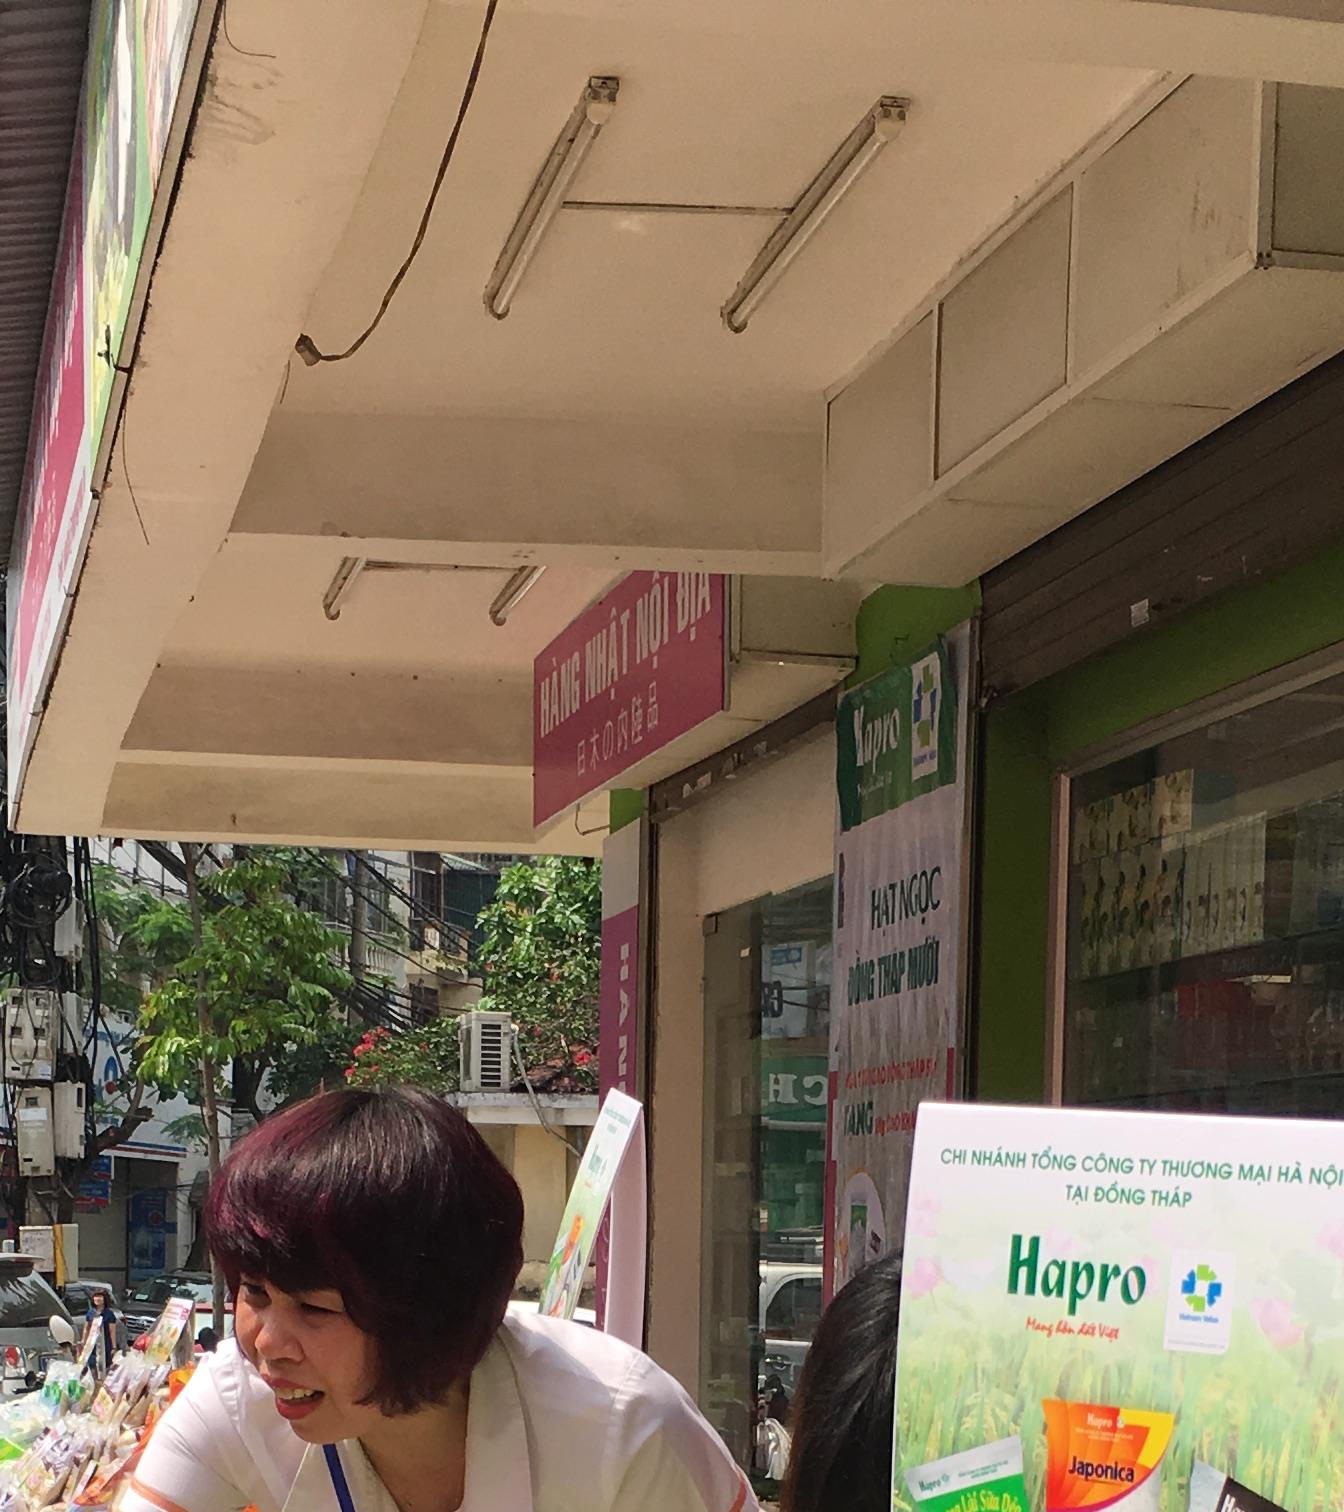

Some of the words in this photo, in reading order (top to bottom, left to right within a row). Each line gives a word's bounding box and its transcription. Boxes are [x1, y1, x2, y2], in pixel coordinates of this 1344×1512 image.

[541, 651, 580, 738] HÀNG
[585, 607, 631, 703] NHẬT
[636, 572, 669, 670] NỘI
[871, 888, 897, 937] HẠT
[898, 865, 942, 925] NGỌC
[940, 1148, 967, 1167] CHI
[971, 1145, 1027, 1169] NHÁNH
[1031, 1145, 1076, 1173] TỔNG
[1081, 1152, 1134, 1176] CÔNG
[1138, 1157, 1157, 1176] TY
[1161, 1157, 1233, 1182] THƯƠNG
[1238, 1164, 1273, 1188] MẠI
[1277, 1158, 1303, 1184] HÀ
[1065, 1182, 1089, 1207] TẠI
[1093, 1180, 1145, 1206] ĐỒNG
[1150, 1184, 1193, 1208] THÁP
[1007, 1233, 1147, 1316] Hapro
[1068, 1456, 1135, 1483] Japonica
